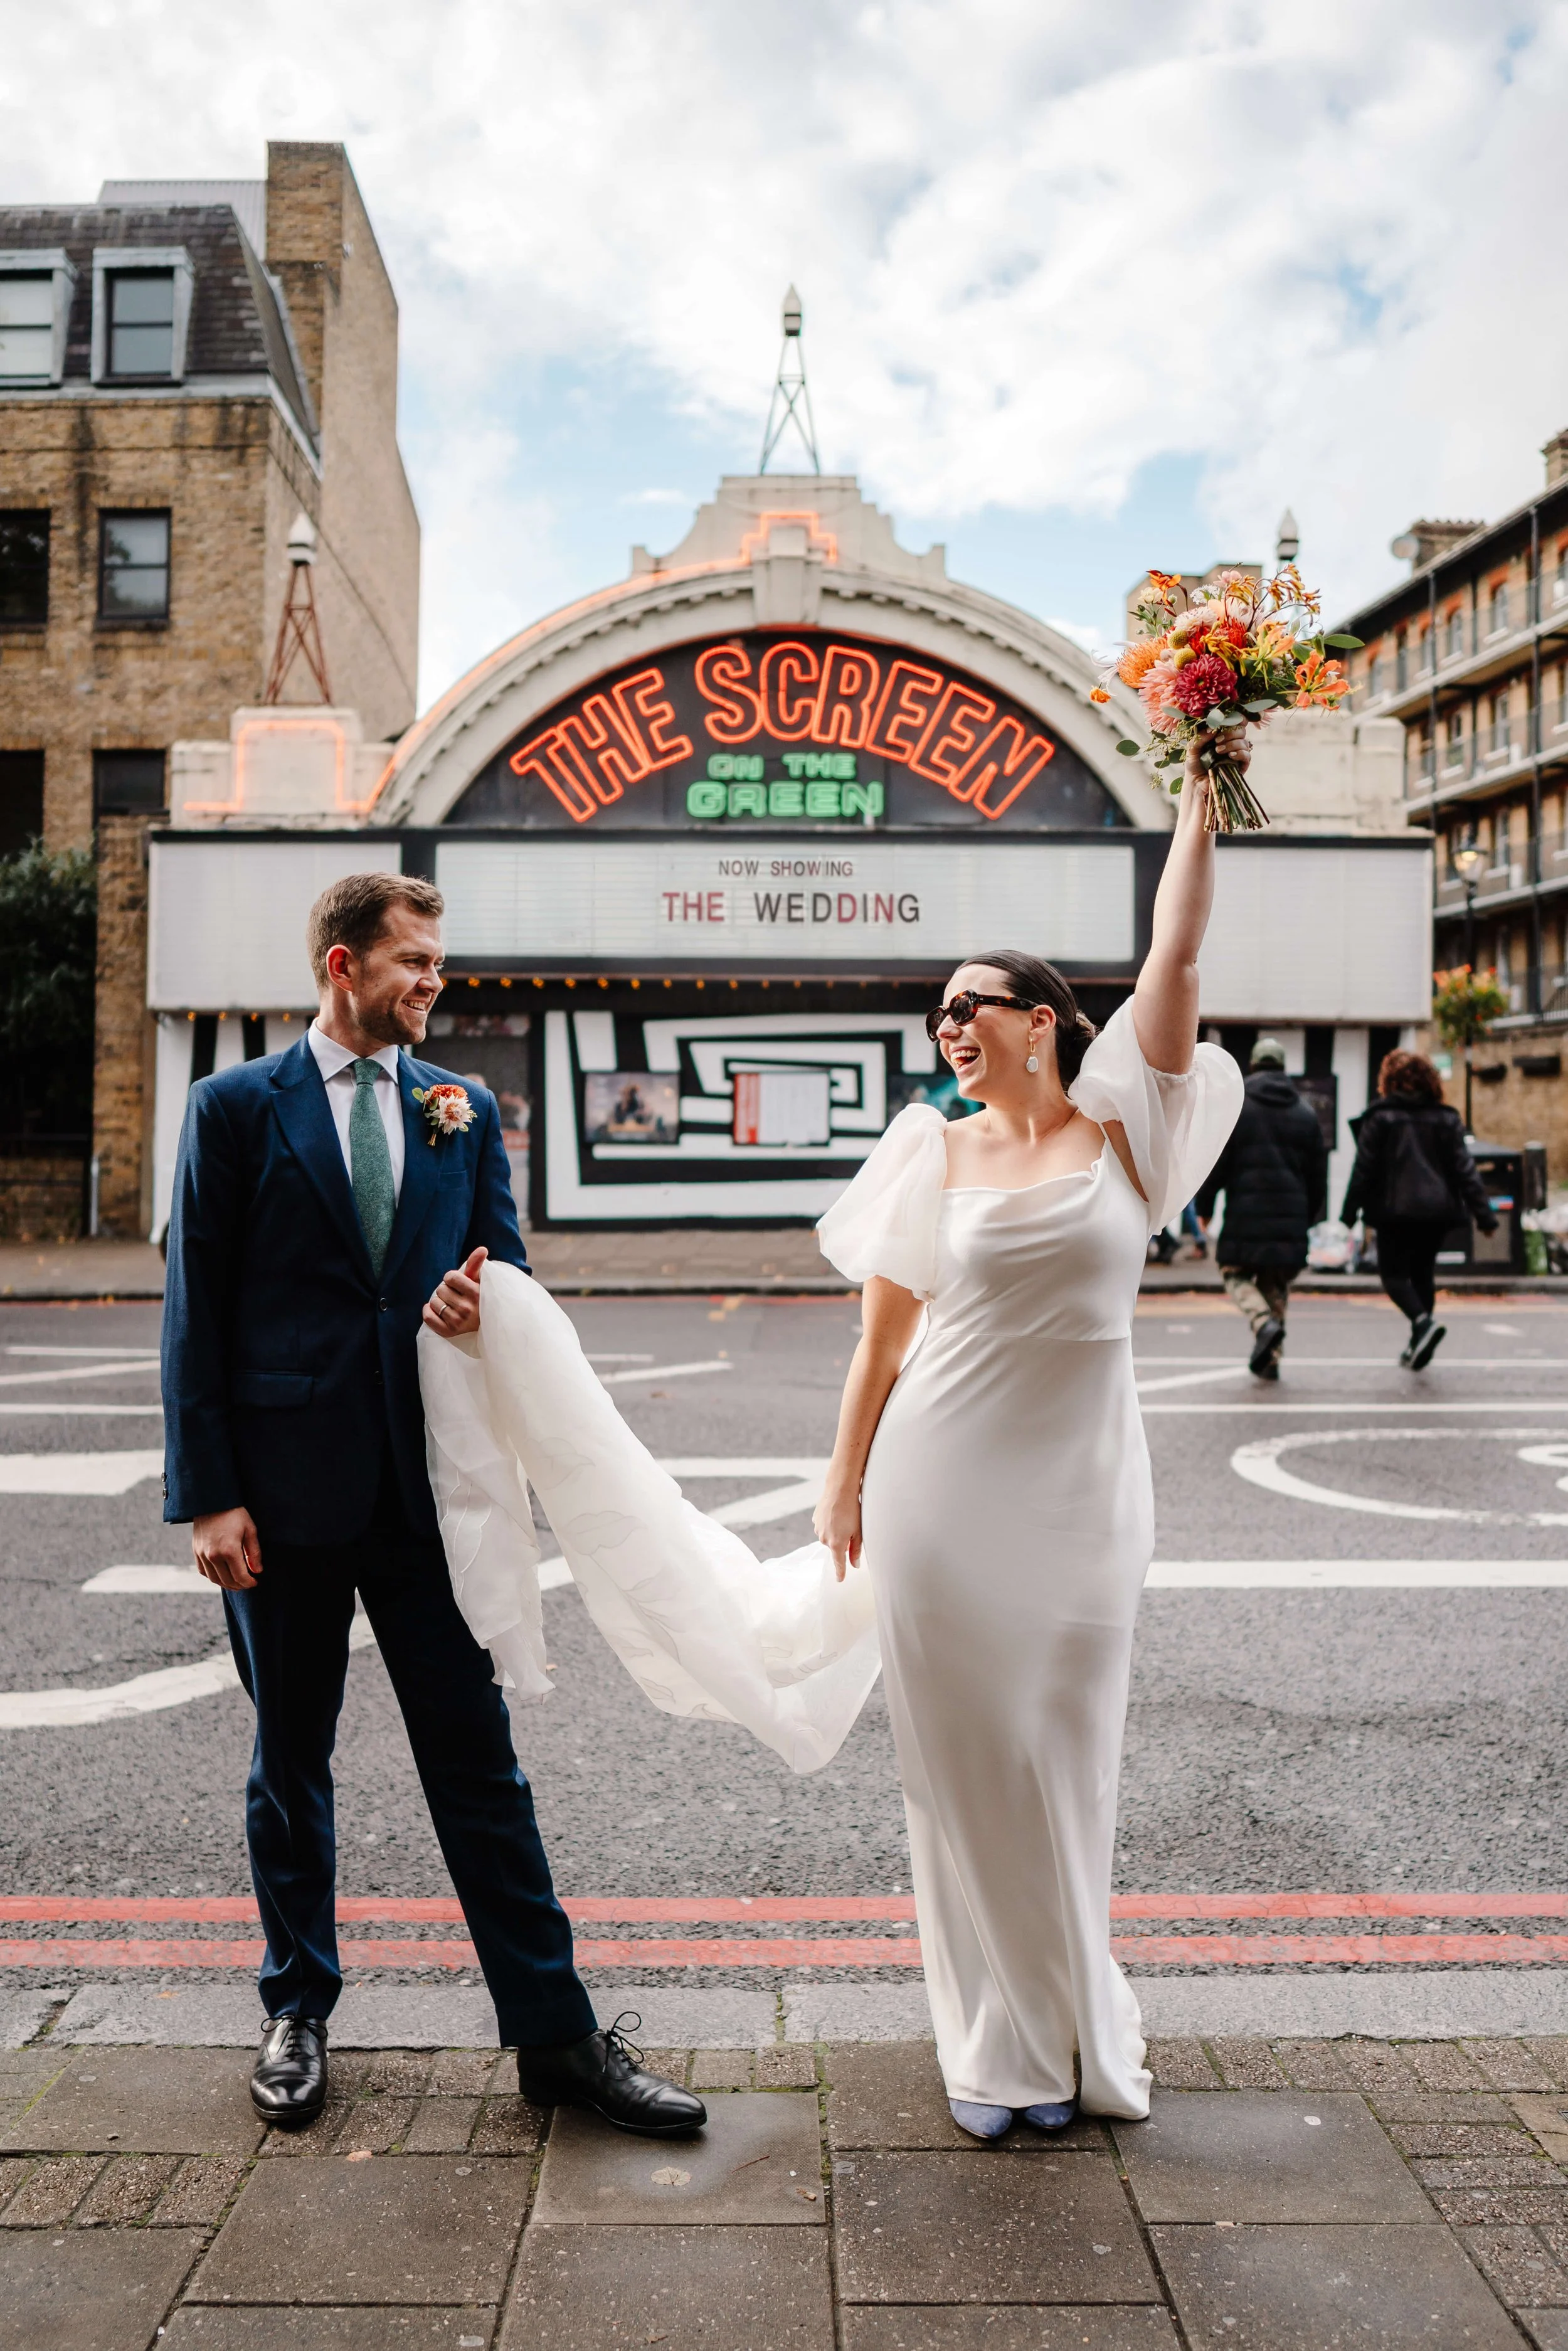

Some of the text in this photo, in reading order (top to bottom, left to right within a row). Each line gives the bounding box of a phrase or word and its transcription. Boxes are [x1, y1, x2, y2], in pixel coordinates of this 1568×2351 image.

[510, 641, 1055, 823] THE SCREEN
[707, 752, 857, 780] ON THE
[687, 781, 884, 817] GREEN
[719, 861, 854, 877] NOW SHOWING
[662, 892, 920, 923] THE WEDDING
